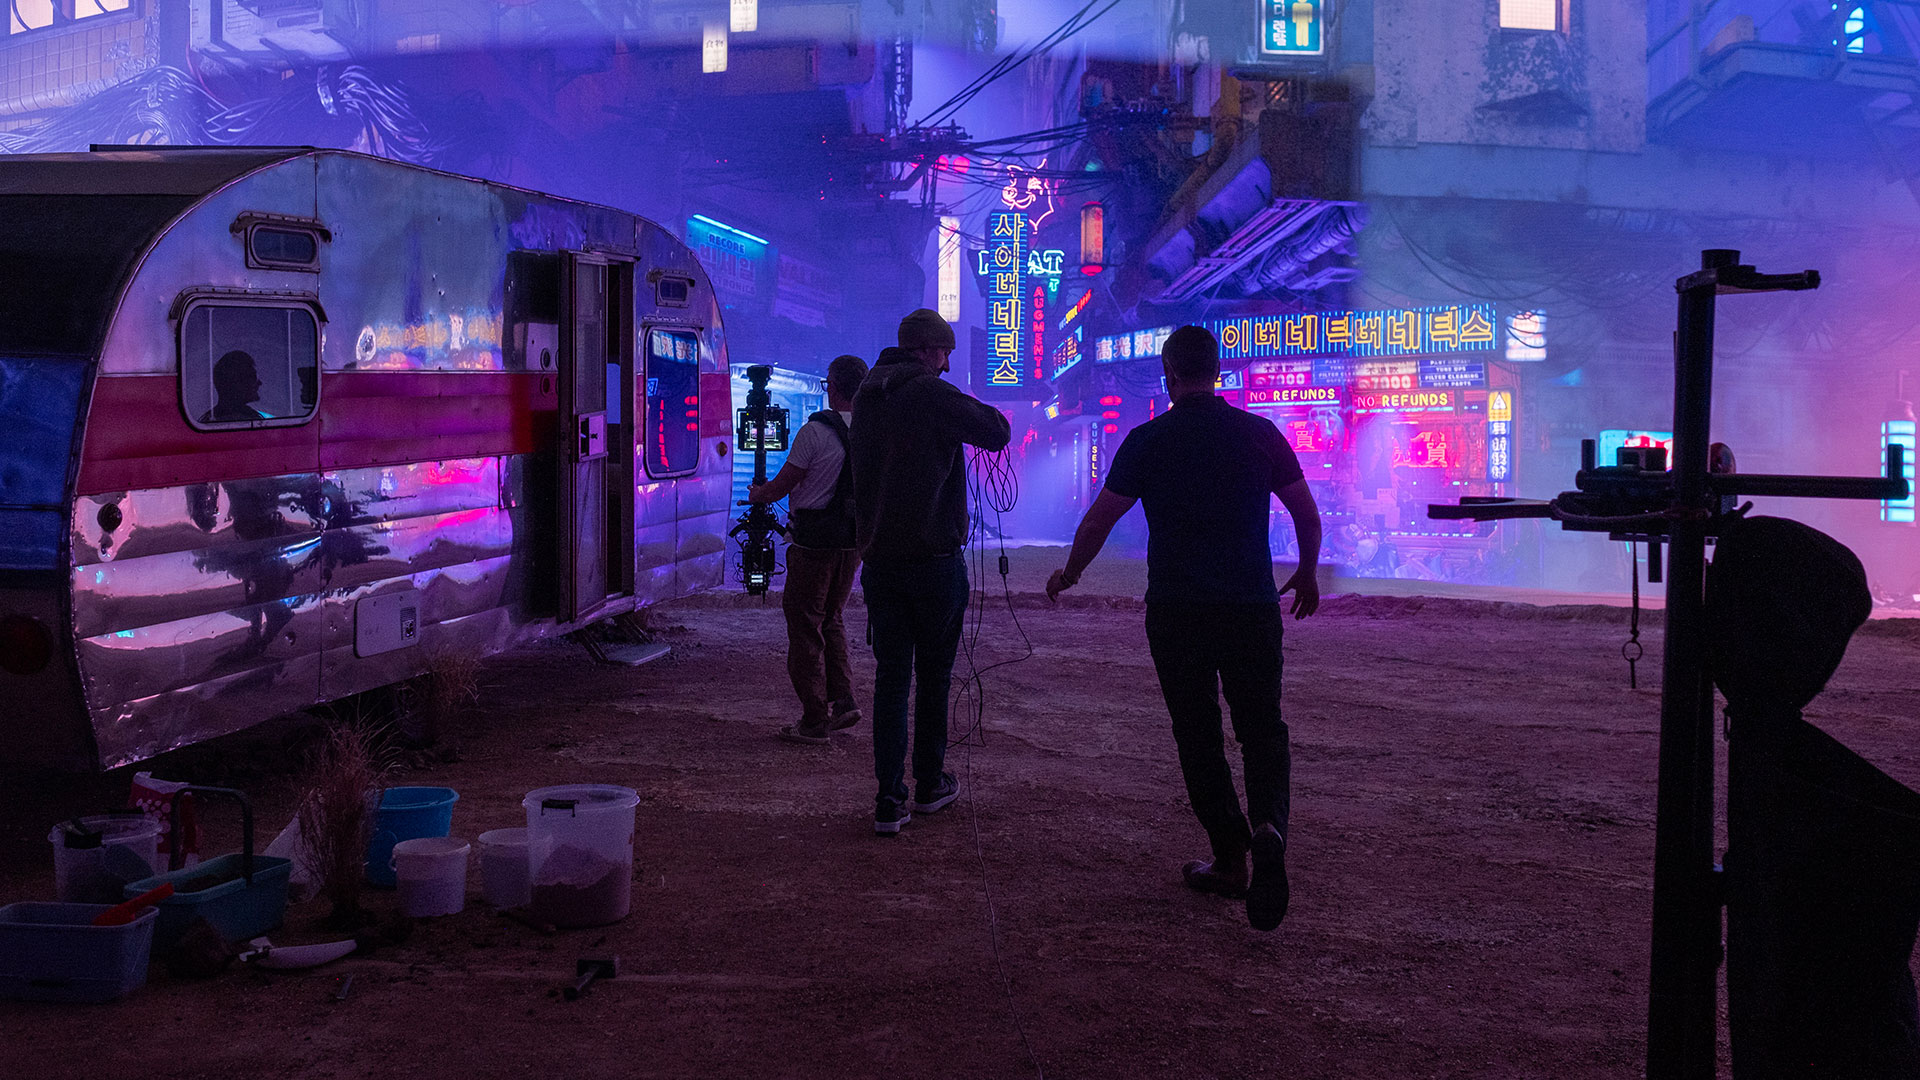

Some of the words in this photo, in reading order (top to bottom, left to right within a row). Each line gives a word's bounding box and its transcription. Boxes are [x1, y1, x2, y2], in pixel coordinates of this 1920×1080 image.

[993, 213, 1024, 383] 사이버네틱스
[1033, 286, 1045, 379] AUGMENTS
[1249, 391, 1267, 402] NO
[1273, 388, 1335, 401] REFUNDS
[1357, 396, 1375, 408] NO
[1382, 392, 1448, 407] REFUNDS
